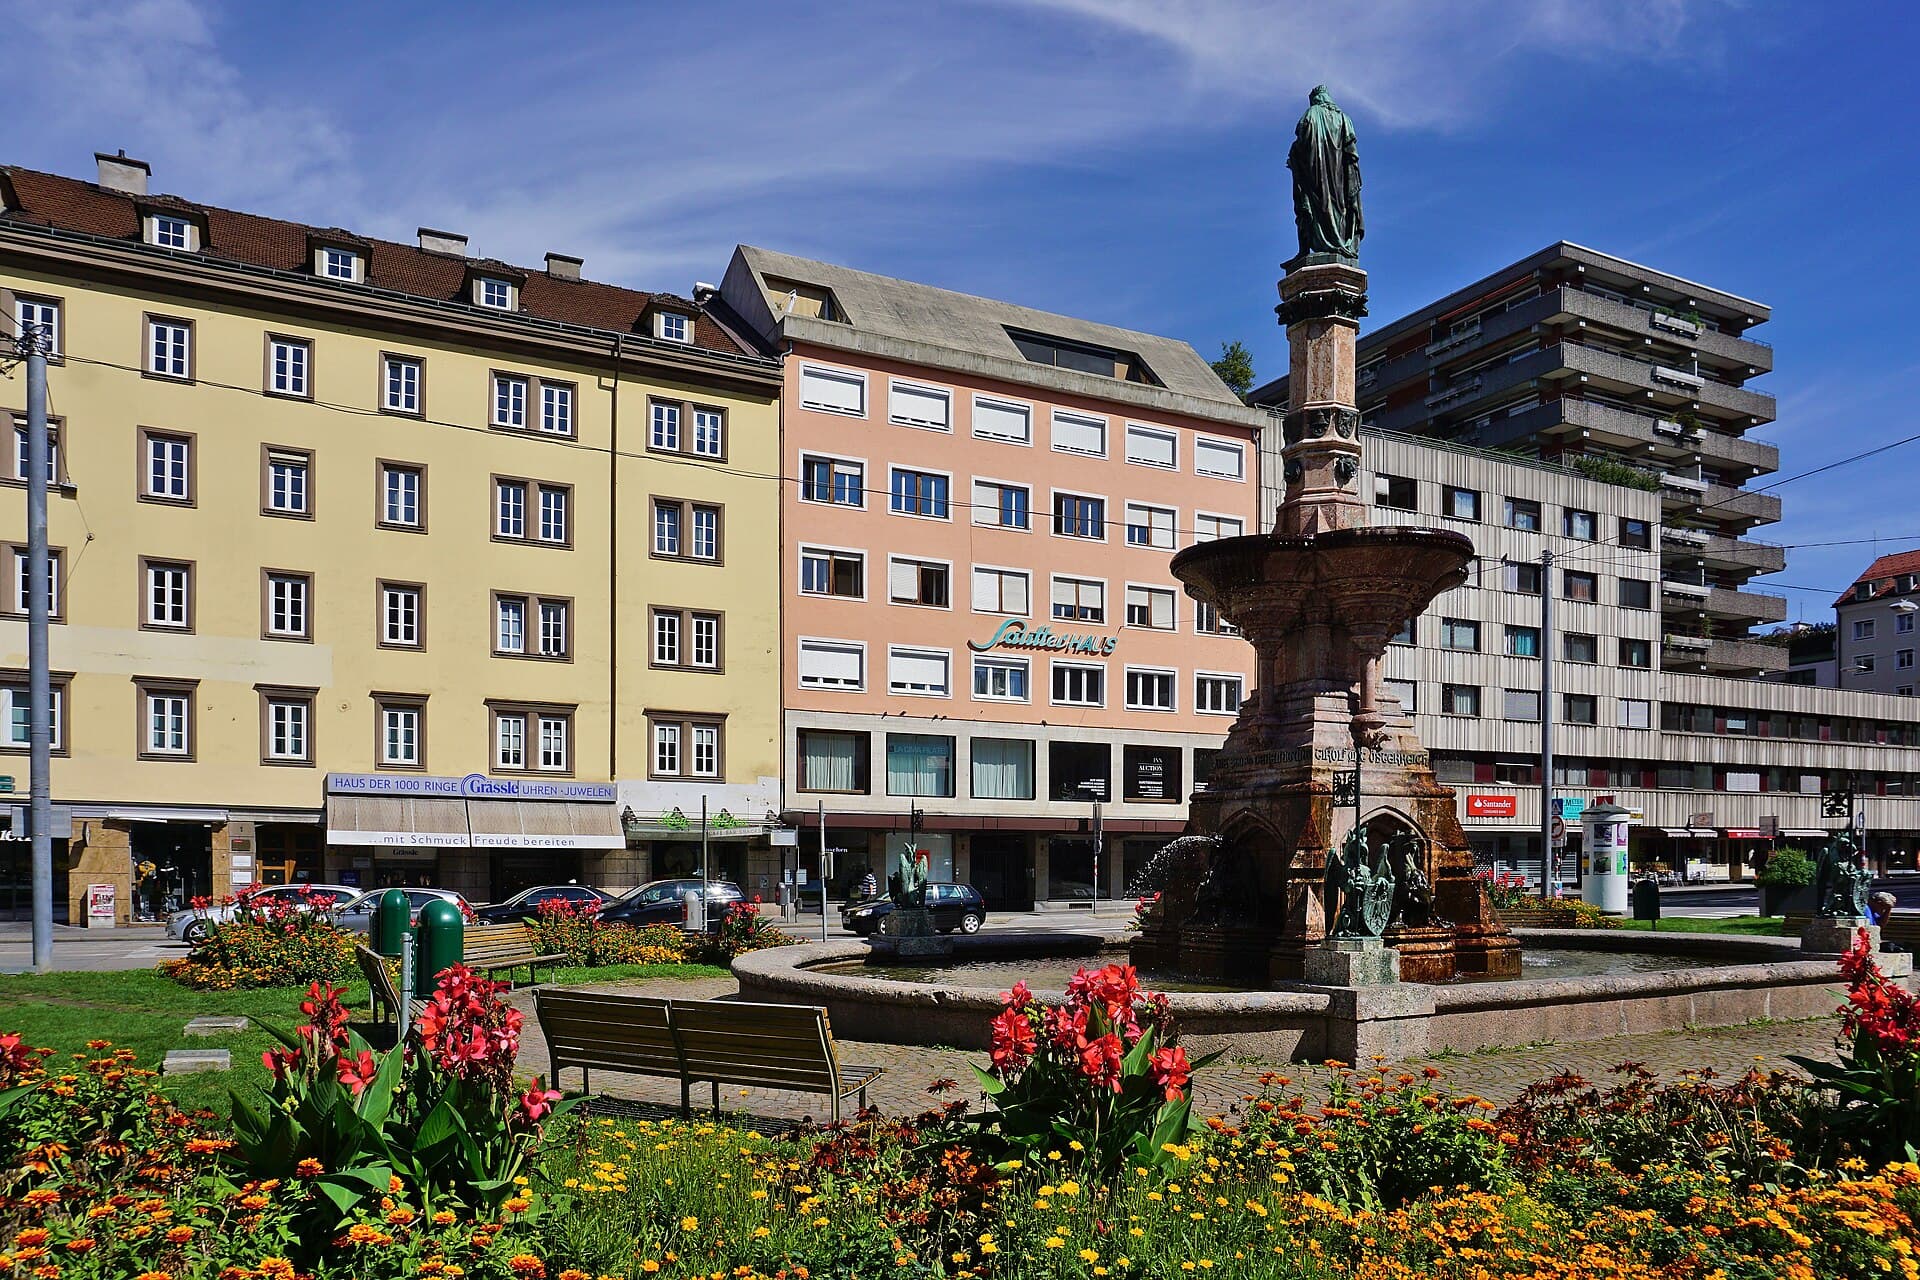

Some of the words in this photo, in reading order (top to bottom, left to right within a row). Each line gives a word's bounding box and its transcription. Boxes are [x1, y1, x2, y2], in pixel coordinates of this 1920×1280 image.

[335, 777, 366, 789] HAUS
[369, 779, 391, 789] DER
[395, 780, 420, 790] 1000
[424, 781, 457, 792] RINGE
[469, 779, 519, 794] Grässle
[522, 785, 558, 796] UHREN
[565, 786, 611, 797] JUWELEN
[1482, 800, 1511, 808] Santander
[410, 835, 467, 845] Schmuck
[474, 836, 518, 845] Freude
[523, 837, 575, 846] bereiten
